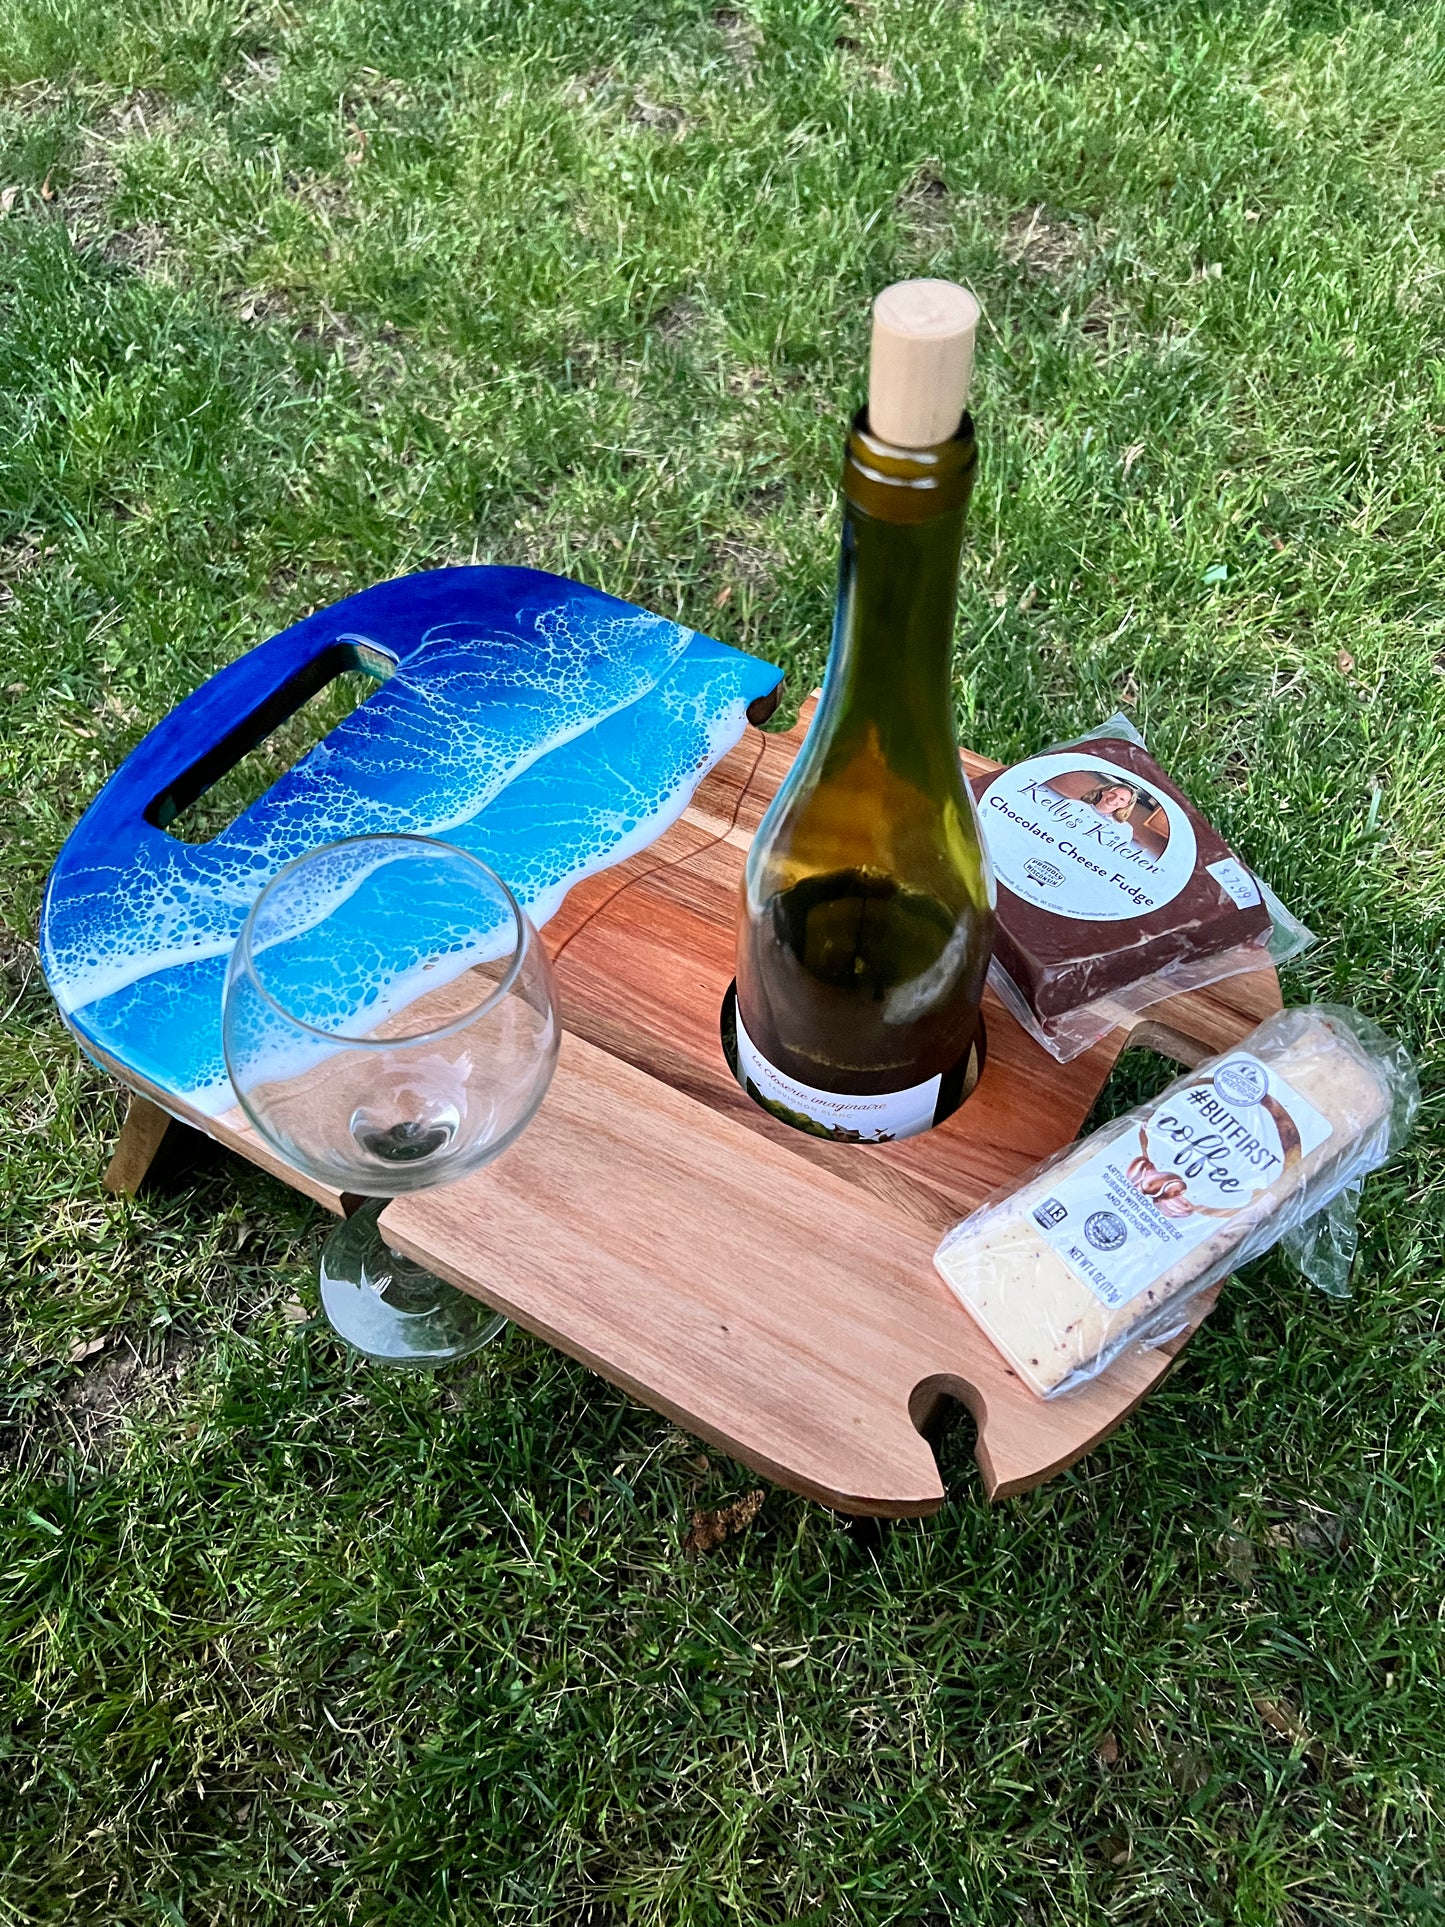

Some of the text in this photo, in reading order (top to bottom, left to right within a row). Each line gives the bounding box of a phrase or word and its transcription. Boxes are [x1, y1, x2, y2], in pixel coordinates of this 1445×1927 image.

[1017, 779, 1083, 828] Kelly's
[990, 796, 1055, 844] Chocolate
[1058, 841, 1107, 877] Cheese
[1109, 873, 1154, 906] Fudge
[1031, 859, 1063, 880] PROUDLY
[1027, 865, 1059, 886] WISCONSIN
[764, 1068, 807, 1100] Closerie
[811, 1097, 887, 1112] imaginaire
[821, 1109, 853, 1118] BLANC
[1186, 1090, 1281, 1171] #BUTFIRST
[1156, 1116, 1244, 1193] coffee
[1101, 1172, 1126, 1198] RUBBED
[1125, 1196, 1142, 1213] WITH
[1139, 1211, 1170, 1242] ESPRESSO
[1104, 1192, 1121, 1207] AND
[1118, 1204, 1151, 1238] LAVENDER
[1105, 1164, 1184, 1241] ARTISAN CHEDDAR CHEESE
[1067, 1245, 1085, 1261] NET
[1079, 1256, 1094, 1271] WT
[1092, 1272, 1106, 1285] OZ
